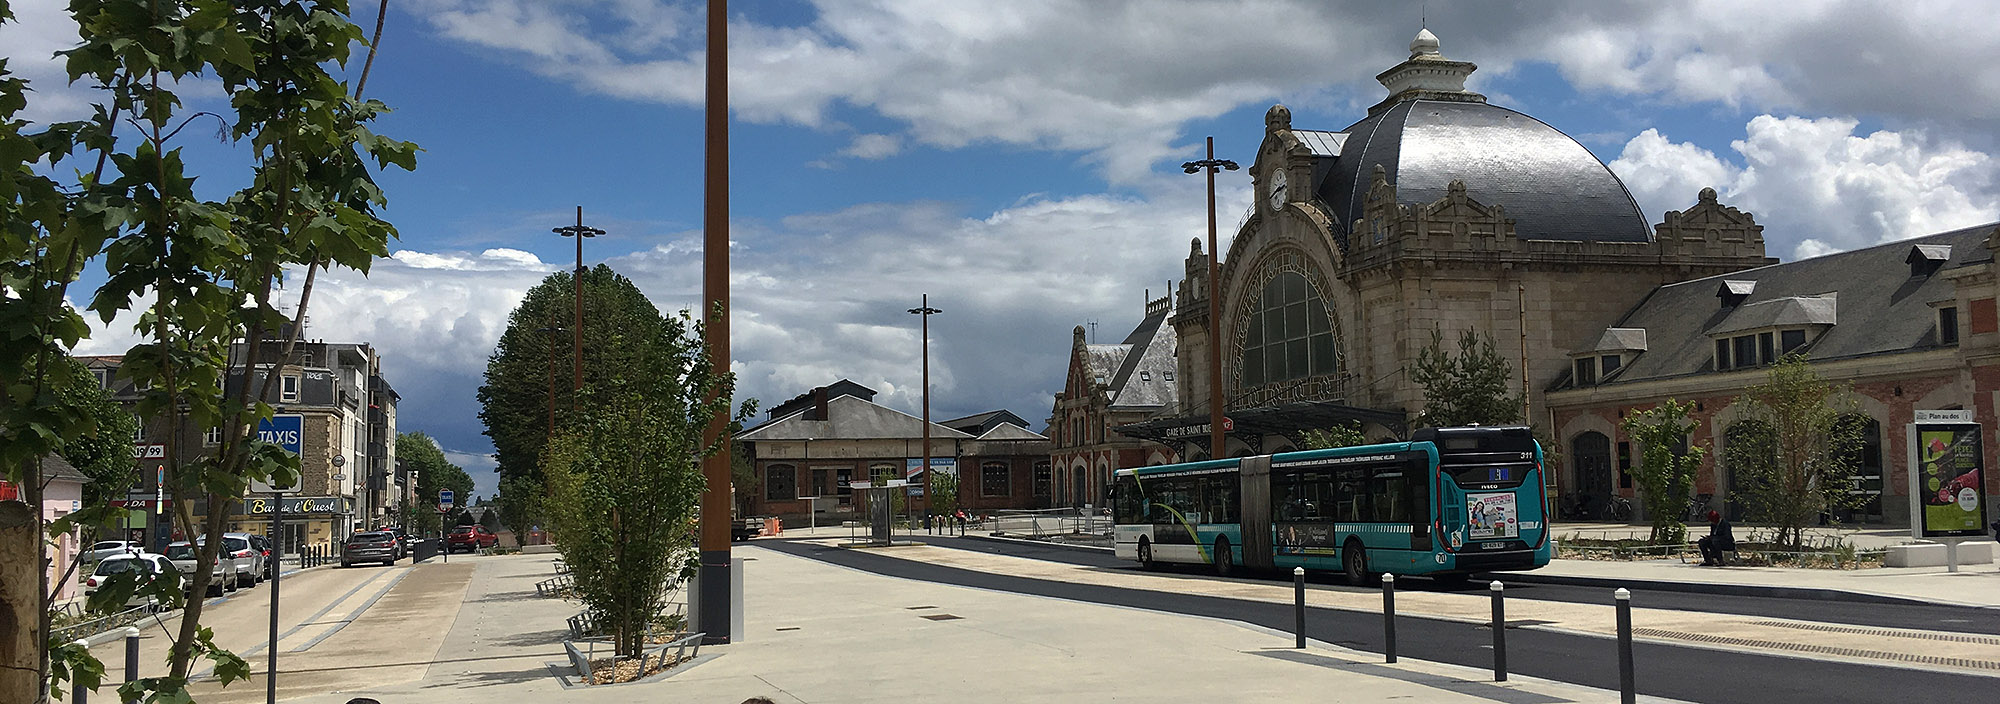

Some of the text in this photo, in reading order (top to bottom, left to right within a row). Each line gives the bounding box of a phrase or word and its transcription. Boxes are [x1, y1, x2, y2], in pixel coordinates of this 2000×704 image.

[1180, 427, 1185, 436] DE
[1186, 425, 1201, 435] SAINT
[258, 430, 298, 445] TAXIS
[149, 447, 161, 455] 99
[281, 504, 290, 512] de
[294, 499, 335, 512] l'Ouest
